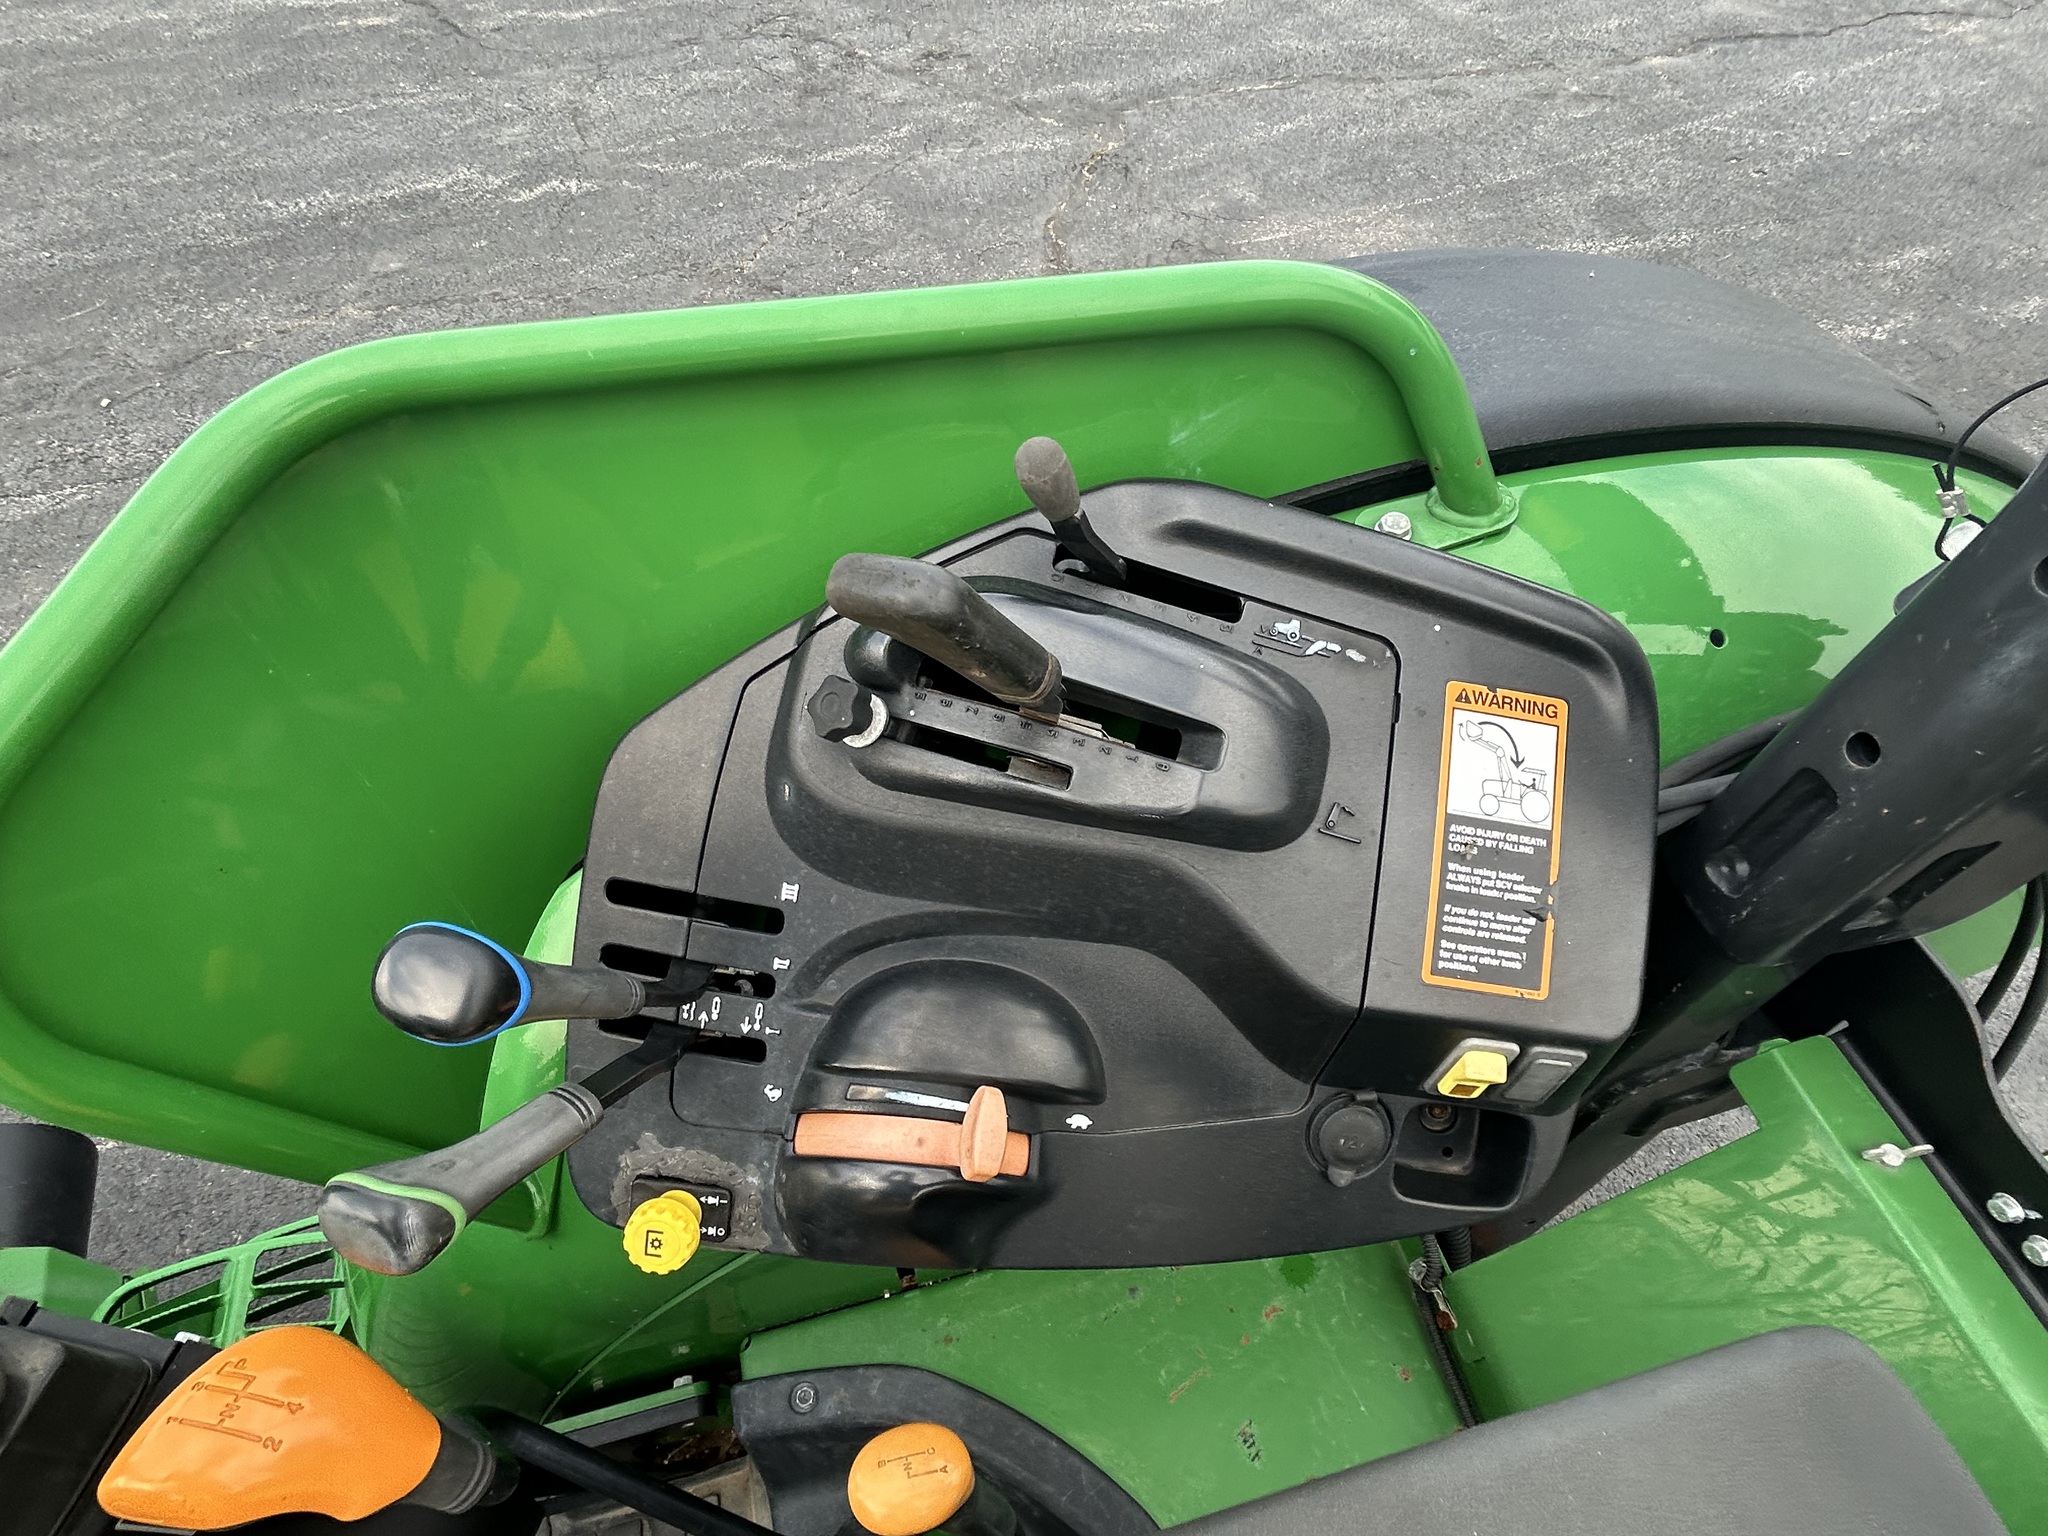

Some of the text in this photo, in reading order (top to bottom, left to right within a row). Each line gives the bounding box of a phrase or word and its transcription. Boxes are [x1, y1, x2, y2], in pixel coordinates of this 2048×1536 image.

[1472, 690, 1558, 719] WARNING
[1073, 738, 1085, 746] 3
[1099, 746, 1112, 755] 2
[1156, 762, 1170, 772] 0
[1449, 824, 1547, 847] AVOID INJURY OR DEATH
[1485, 839, 1498, 848] BY
[1499, 841, 1534, 855] FALLING
[1448, 862, 1525, 882] When using loader
[1447, 872, 1481, 884] ALWAYS
[1496, 880, 1512, 890] SCV
[781, 882, 800, 903] III
[1451, 906, 1467, 915] you
[1467, 908, 1479, 917] do
[1443, 915, 1478, 927] continue
[1479, 920, 1488, 928] to
[1489, 922, 1512, 931] move
[1442, 925, 1476, 936] controls
[1476, 930, 1490, 938] are
[1441, 939, 1456, 949] See
[773, 957, 791, 970] II
[1439, 949, 1452, 958] for
[1453, 952, 1468, 961] use
[1479, 956, 1501, 966] other
[191, 1381, 205, 1392] 3
[219, 1403, 241, 1419] N
[286, 1401, 305, 1416] 4
[166, 1416, 179, 1425] 1
[262, 1436, 283, 1452] 2
[927, 1447, 935, 1455] C
[878, 1460, 886, 1468] B
[903, 1462, 912, 1471] N
[940, 1465, 948, 1474] A
